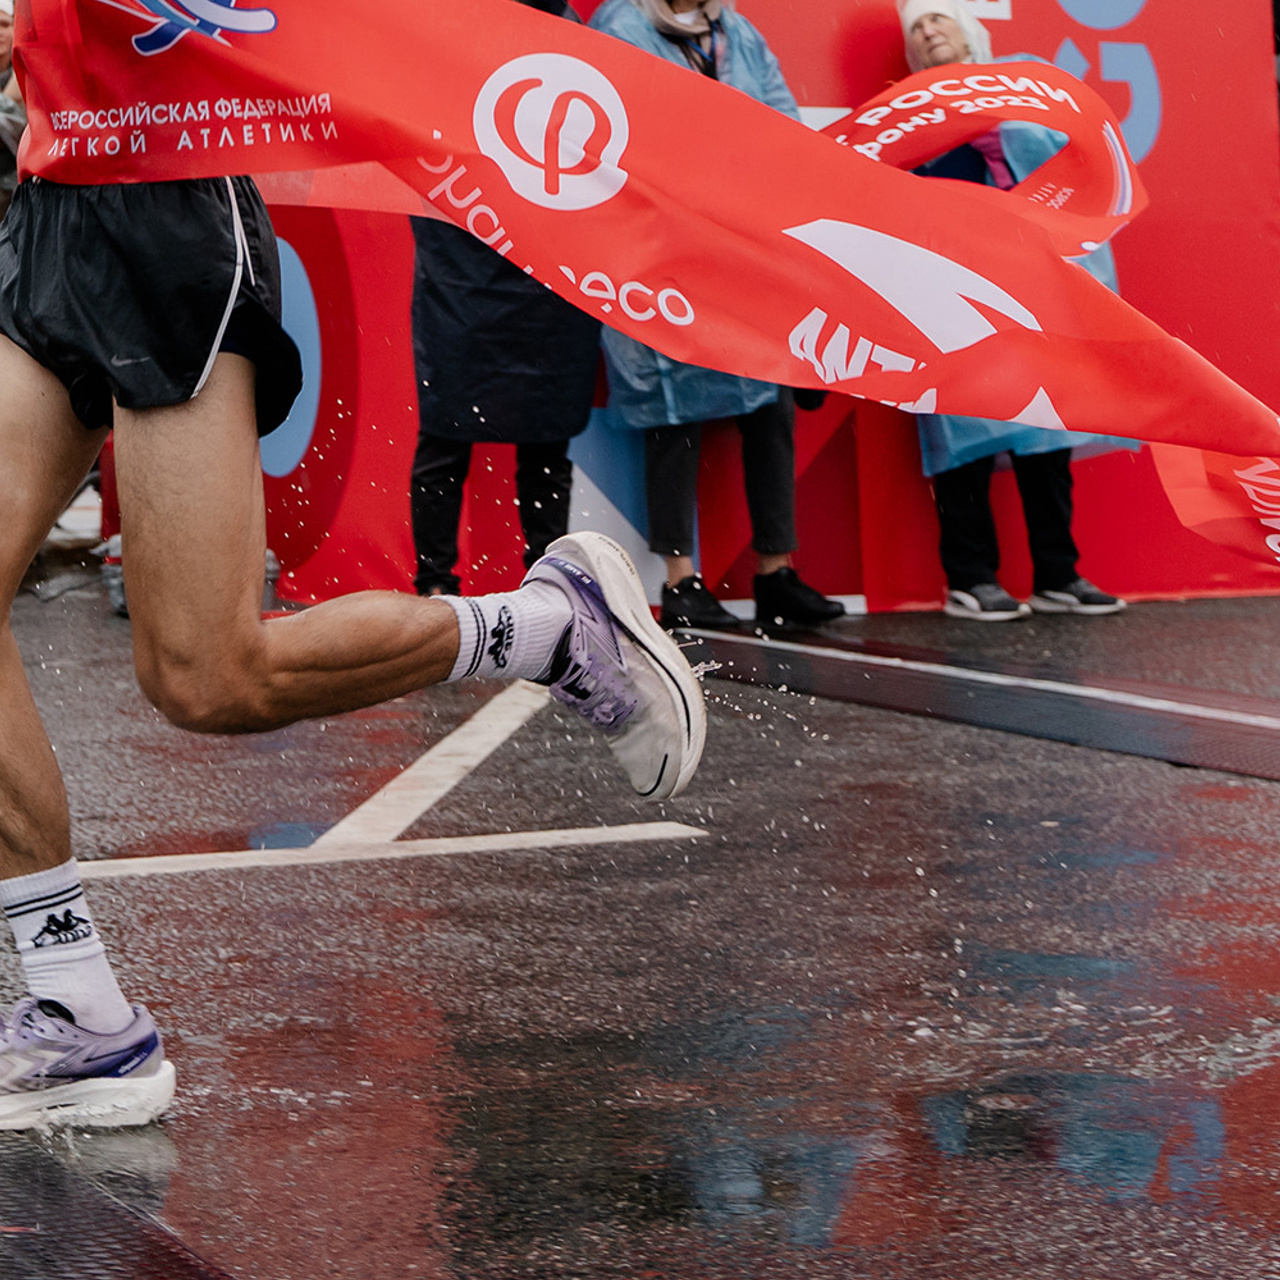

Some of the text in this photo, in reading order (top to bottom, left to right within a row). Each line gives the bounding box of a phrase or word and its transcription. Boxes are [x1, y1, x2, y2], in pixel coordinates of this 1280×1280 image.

[214, 92, 332, 122] ФЕДЕРАЦИЯ
[853, 74, 1082, 128] РОССИИ
[47, 120, 339, 158] ЛЕГКОЙ АТЛЕТИКИ
